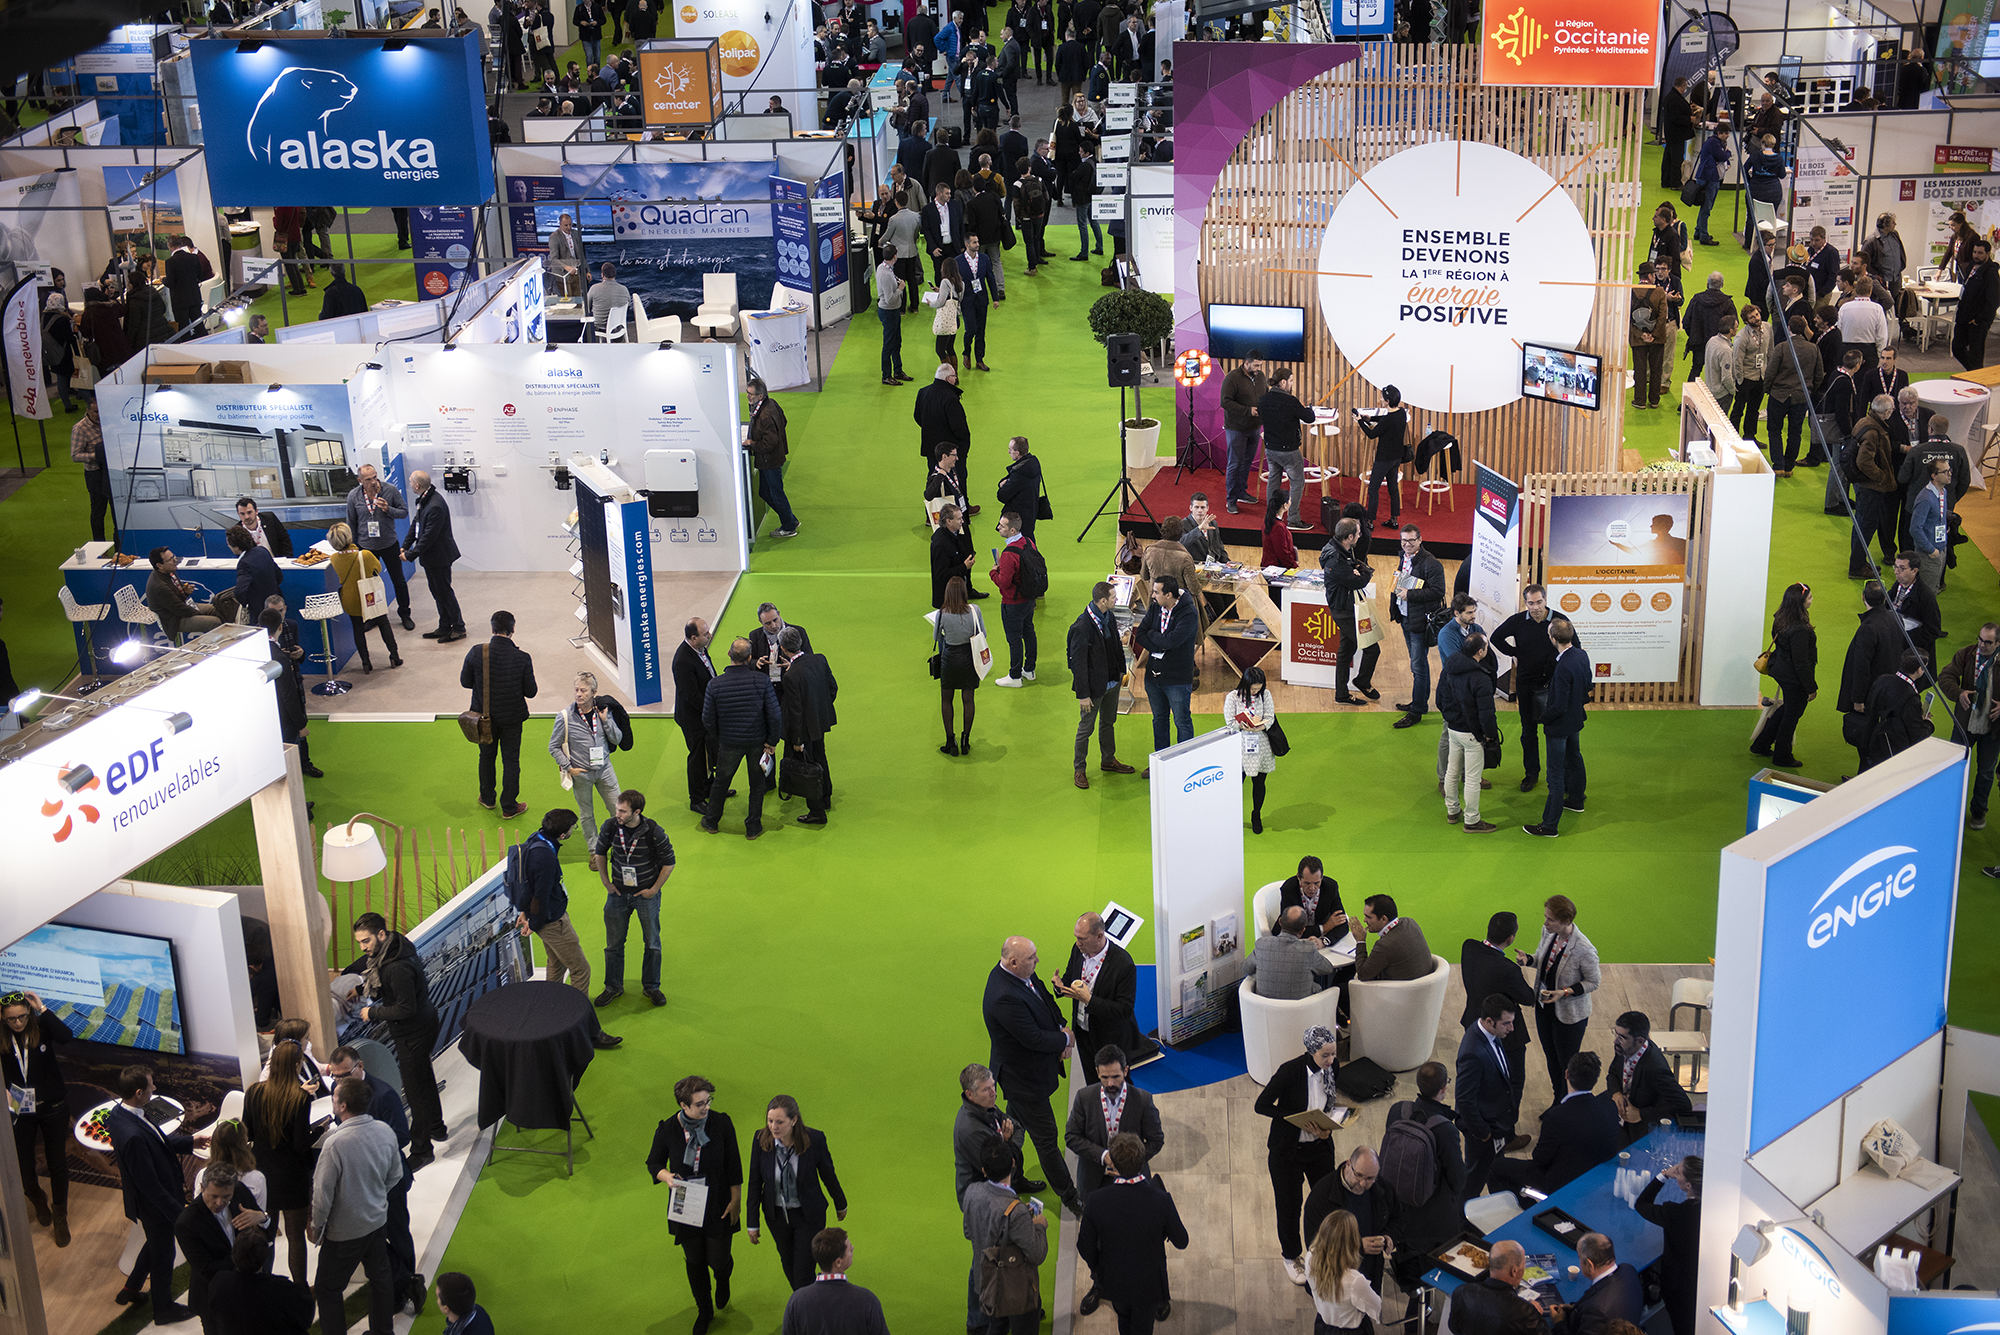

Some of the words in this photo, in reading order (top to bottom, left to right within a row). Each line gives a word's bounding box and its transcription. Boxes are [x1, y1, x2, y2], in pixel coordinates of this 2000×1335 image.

[703, 10, 738, 19] SOLEASE
[1566, 20, 1594, 29] Région
[1554, 28, 1650, 45] Occitanie
[719, 47, 757, 60] Solipac
[1553, 46, 1590, 55] Pyrénées
[1596, 46, 1650, 54] Méditerranée
[653, 100, 701, 110] cemater
[280, 130, 438, 170] alaska
[1958, 148, 1978, 156] FORÊT
[383, 170, 440, 182] energies
[25, 181, 57, 192] ENERCON
[1923, 180, 1937, 188] LES
[1939, 179, 1983, 187] MISSIONS
[1923, 187, 1955, 199] BOIS
[640, 204, 749, 226] Quadran
[641, 227, 696, 235] ÉNERGIES
[701, 226, 750, 234] MARINES
[1403, 229, 1510, 246] ENSEMBLE
[656, 248, 674, 270] est
[1402, 247, 1510, 264] DEVENONS
[1402, 269, 1418, 278] LA
[1446, 268, 1496, 281] RÉGION
[1500, 270, 1509, 281] À
[524, 274, 541, 311] BRL
[1407, 281, 1501, 327] énergie
[1400, 304, 1508, 325] POSITIVE
[16, 300, 36, 382] renewables
[778, 341, 800, 351] Quadran
[547, 368, 583, 377] alaska
[130, 412, 169, 422] alaska
[264, 413, 288, 421] énergie
[290, 413, 315, 421] positive
[1626, 574, 1646, 583] énergies
[634, 530, 653, 681] www.alaska-energies.com
[113, 756, 220, 833] renouvelables
[6, 962, 29, 970] CENTRALE
[30, 965, 49, 973] SOLAIRE
[50, 968, 75, 976] D'ARAMON
